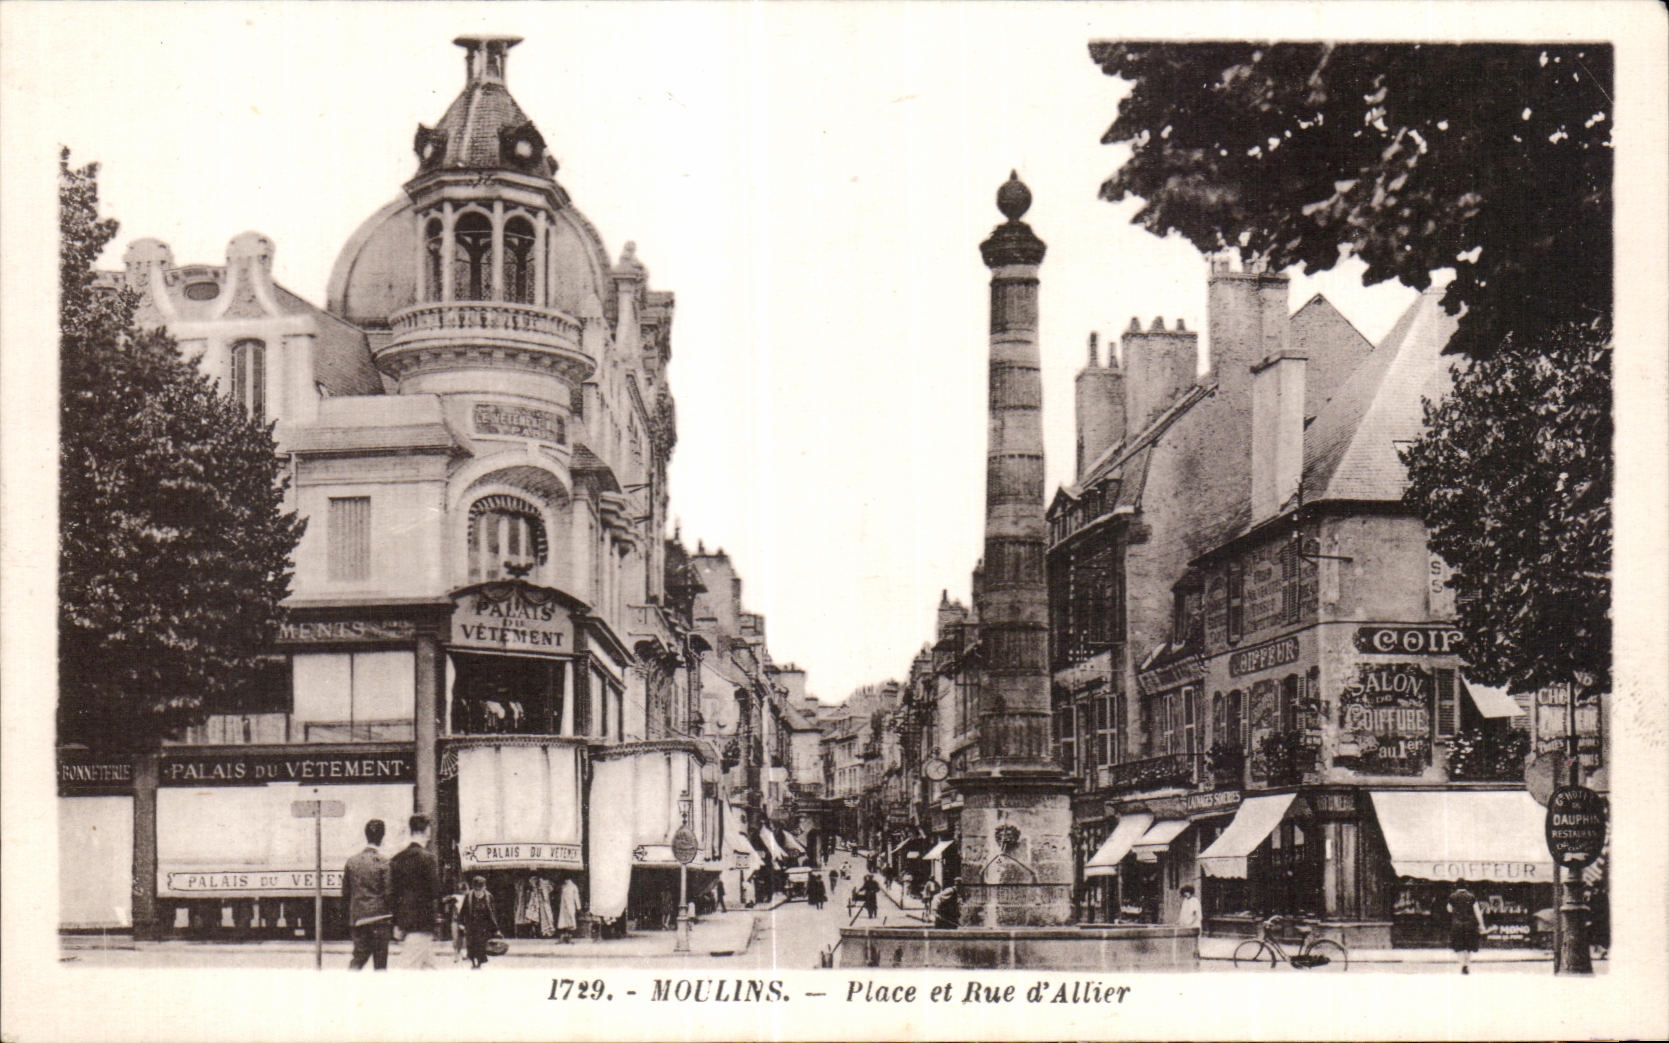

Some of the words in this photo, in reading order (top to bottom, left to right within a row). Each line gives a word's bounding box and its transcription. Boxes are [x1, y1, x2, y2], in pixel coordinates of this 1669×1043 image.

[475, 600, 555, 621] PALAIS
[1347, 671, 1423, 697] SALON
[1345, 703, 1430, 737] COIFFURE
[1379, 745, 1398, 759] au
[62, 764, 131, 781] BONNETERIE
[171, 763, 246, 780] PALAIS
[255, 764, 278, 778] DU
[1552, 813, 1600, 827] DAUPHIN
[486, 846, 520, 859] PALAIS
[530, 847, 542, 858] DU
[1432, 863, 1536, 879] COIFFEUR
[188, 875, 249, 889] PALAIS
[260, 876, 278, 887] DU
